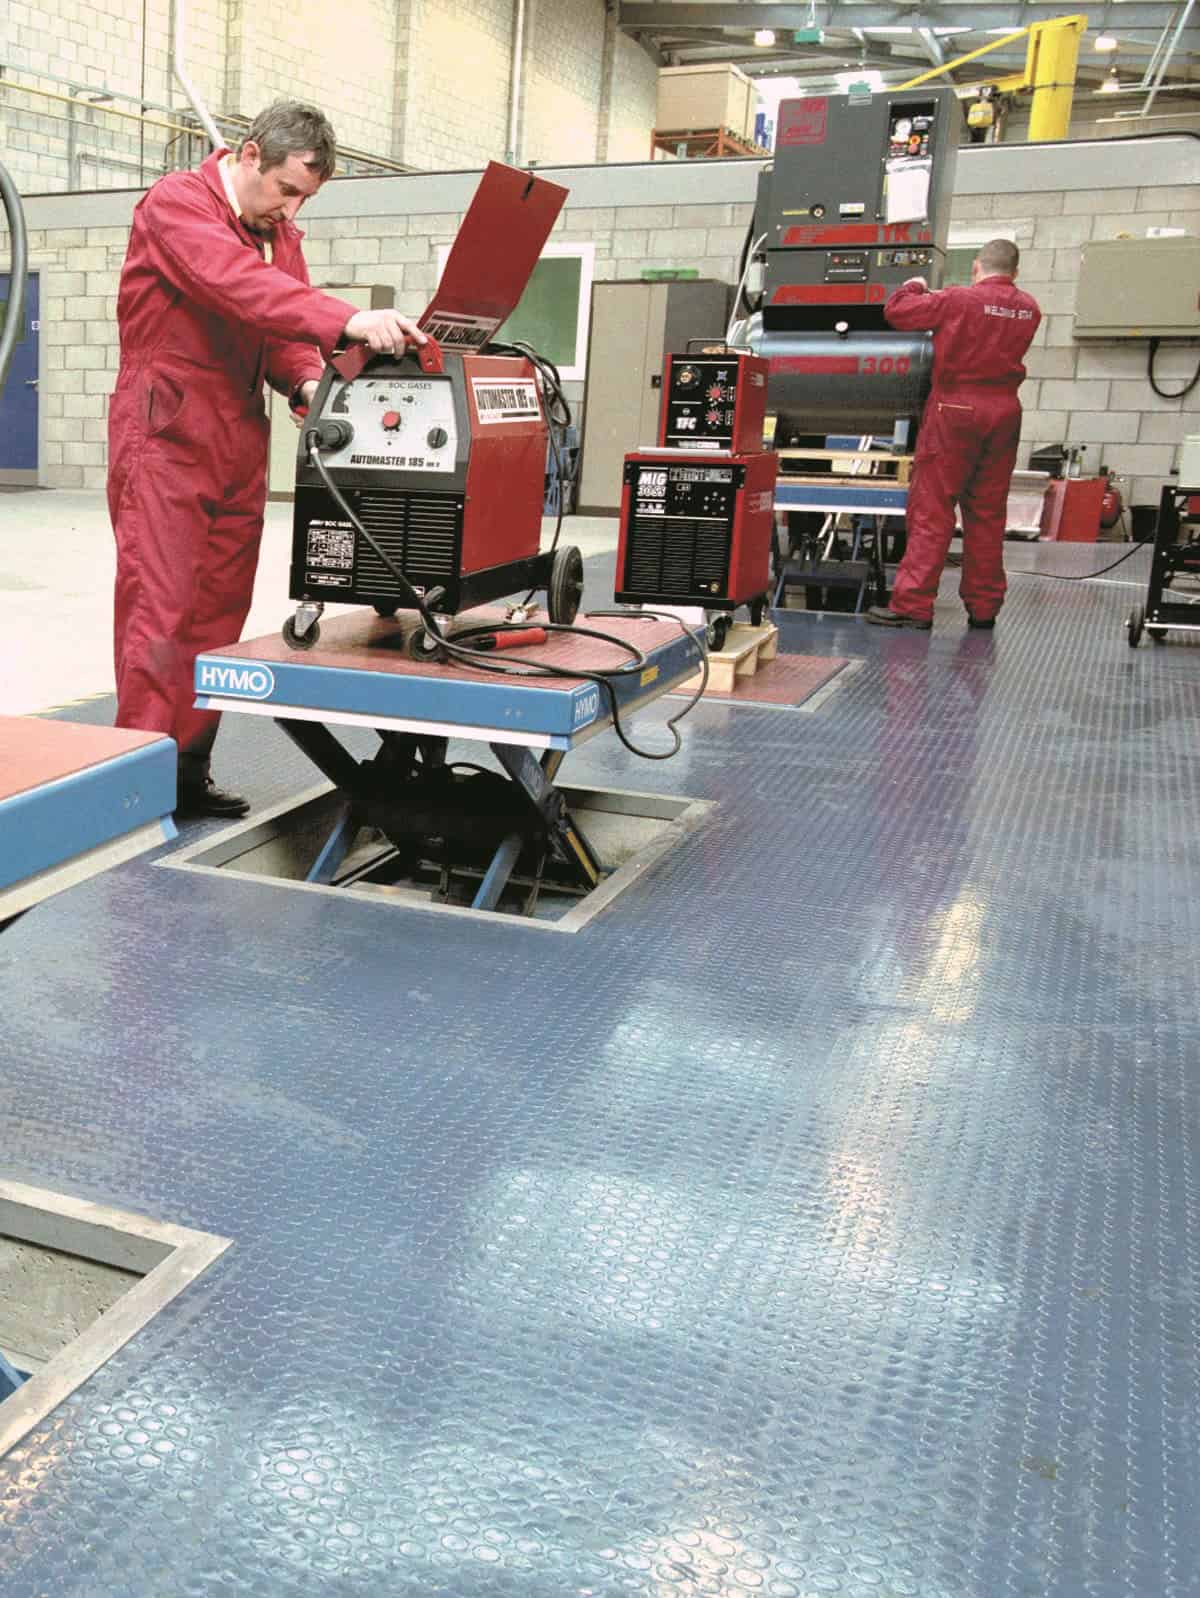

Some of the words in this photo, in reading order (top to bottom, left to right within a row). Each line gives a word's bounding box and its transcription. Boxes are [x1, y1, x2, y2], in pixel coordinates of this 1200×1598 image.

[350, 454, 406, 466] AUTOMASTER
[638, 471, 667, 486] MIG
[201, 667, 268, 693] HYMO
[574, 692, 598, 723] HYMO
